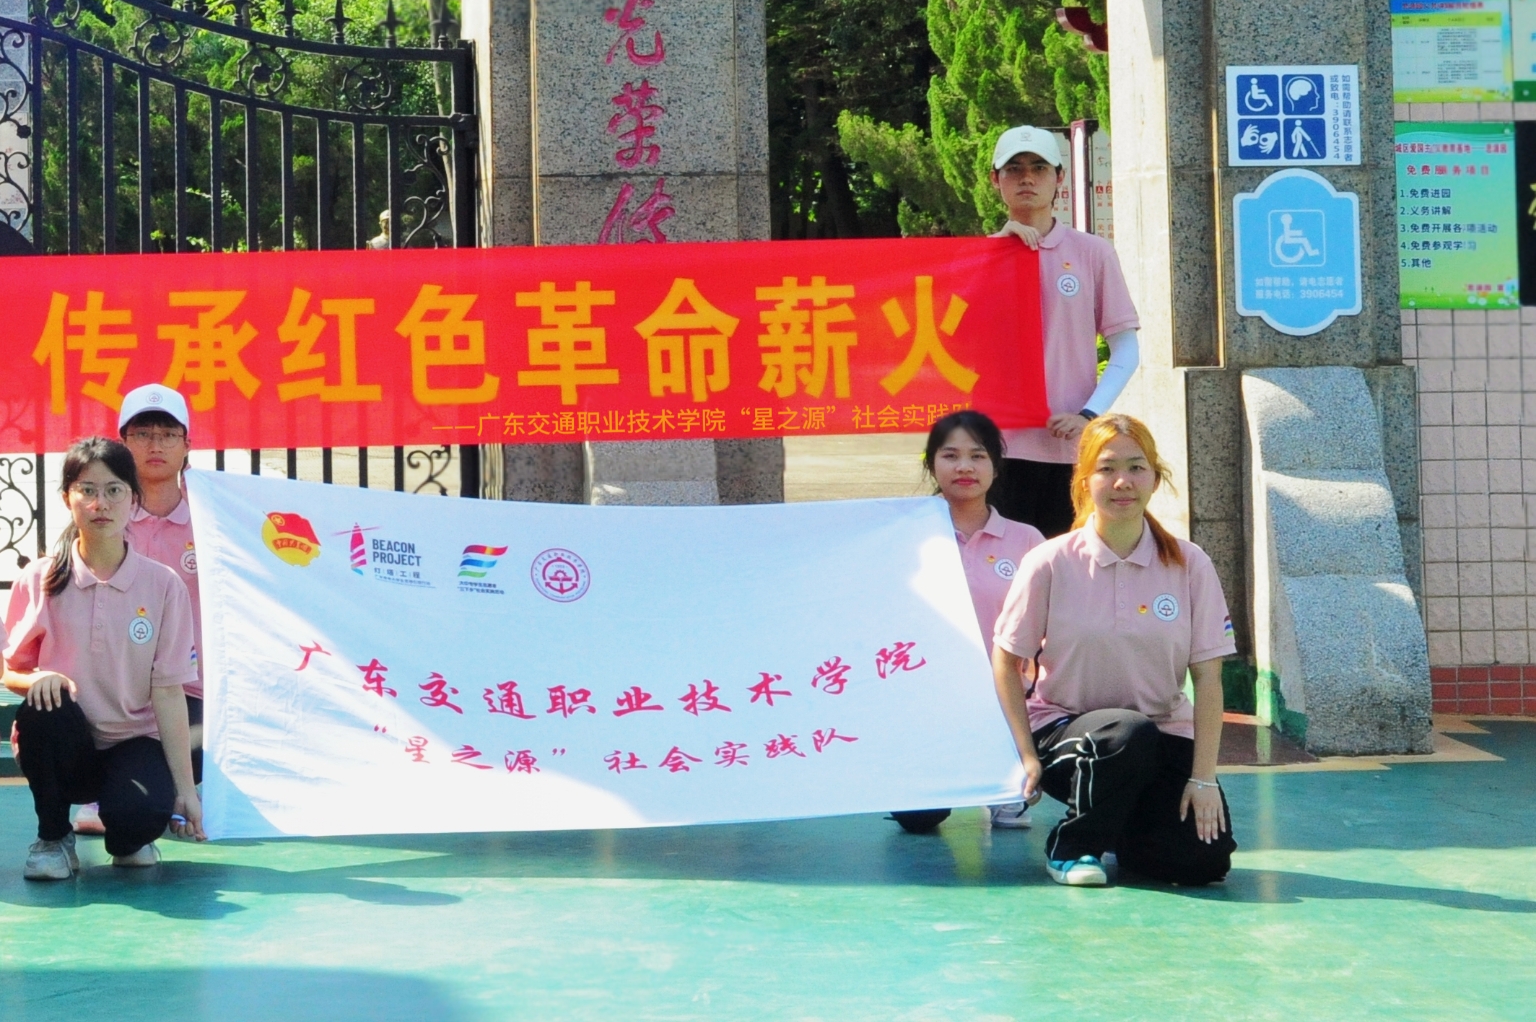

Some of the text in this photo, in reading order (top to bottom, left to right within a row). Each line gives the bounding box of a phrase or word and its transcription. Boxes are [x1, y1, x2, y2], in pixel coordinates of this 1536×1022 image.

[1400, 188, 1451, 199] 1.免费进园
[1400, 206, 1452, 216] 2.义务讲解
[1400, 224, 1498, 234] 3.免费开展各项活动
[1400, 241, 1477, 251] 4.免费参观学习
[1401, 258, 1432, 268] 5.其他
[372, 538, 416, 554] BEACON
[372, 551, 422, 567] PROJECT
[293, 640, 927, 720] 广东交通职业技术学院
